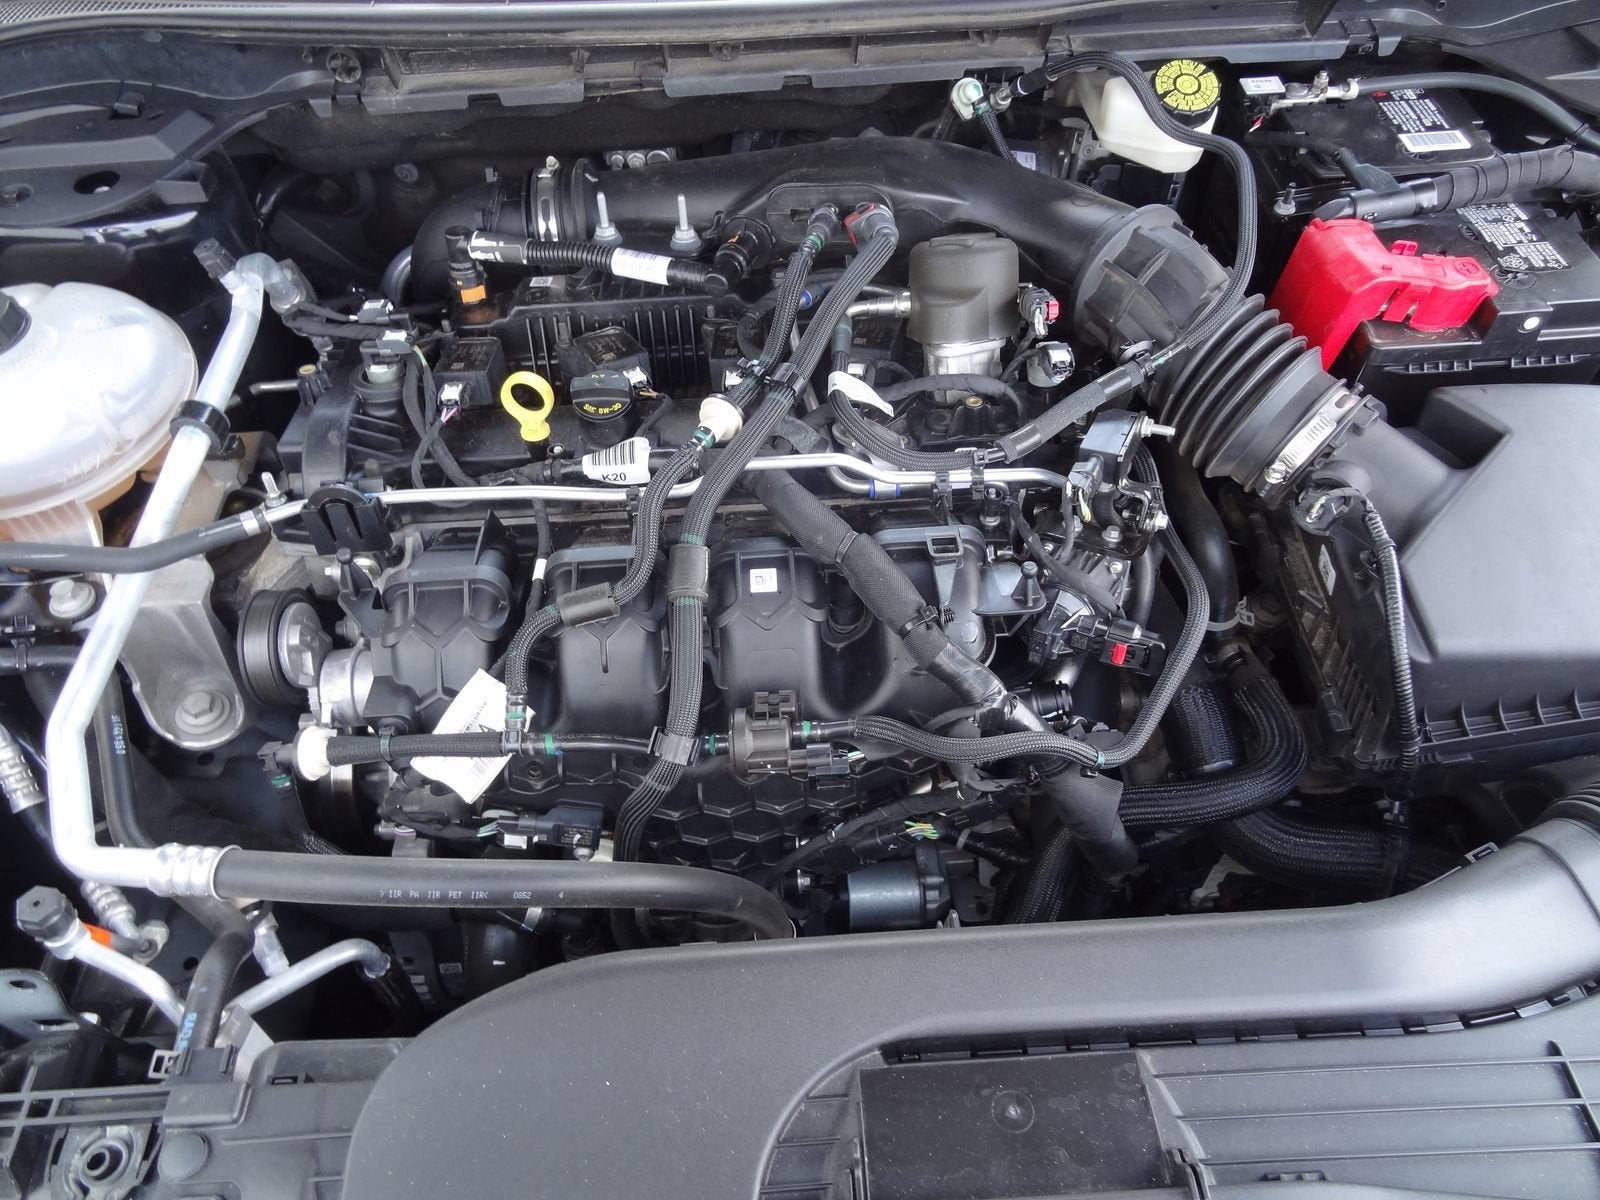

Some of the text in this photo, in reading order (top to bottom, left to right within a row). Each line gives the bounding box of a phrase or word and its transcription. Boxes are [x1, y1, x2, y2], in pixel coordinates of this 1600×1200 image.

[583, 402, 622, 414] SAE 5W-30
[602, 472, 627, 482] K20
[409, 890, 420, 899] PA
[448, 890, 463, 900] PET
